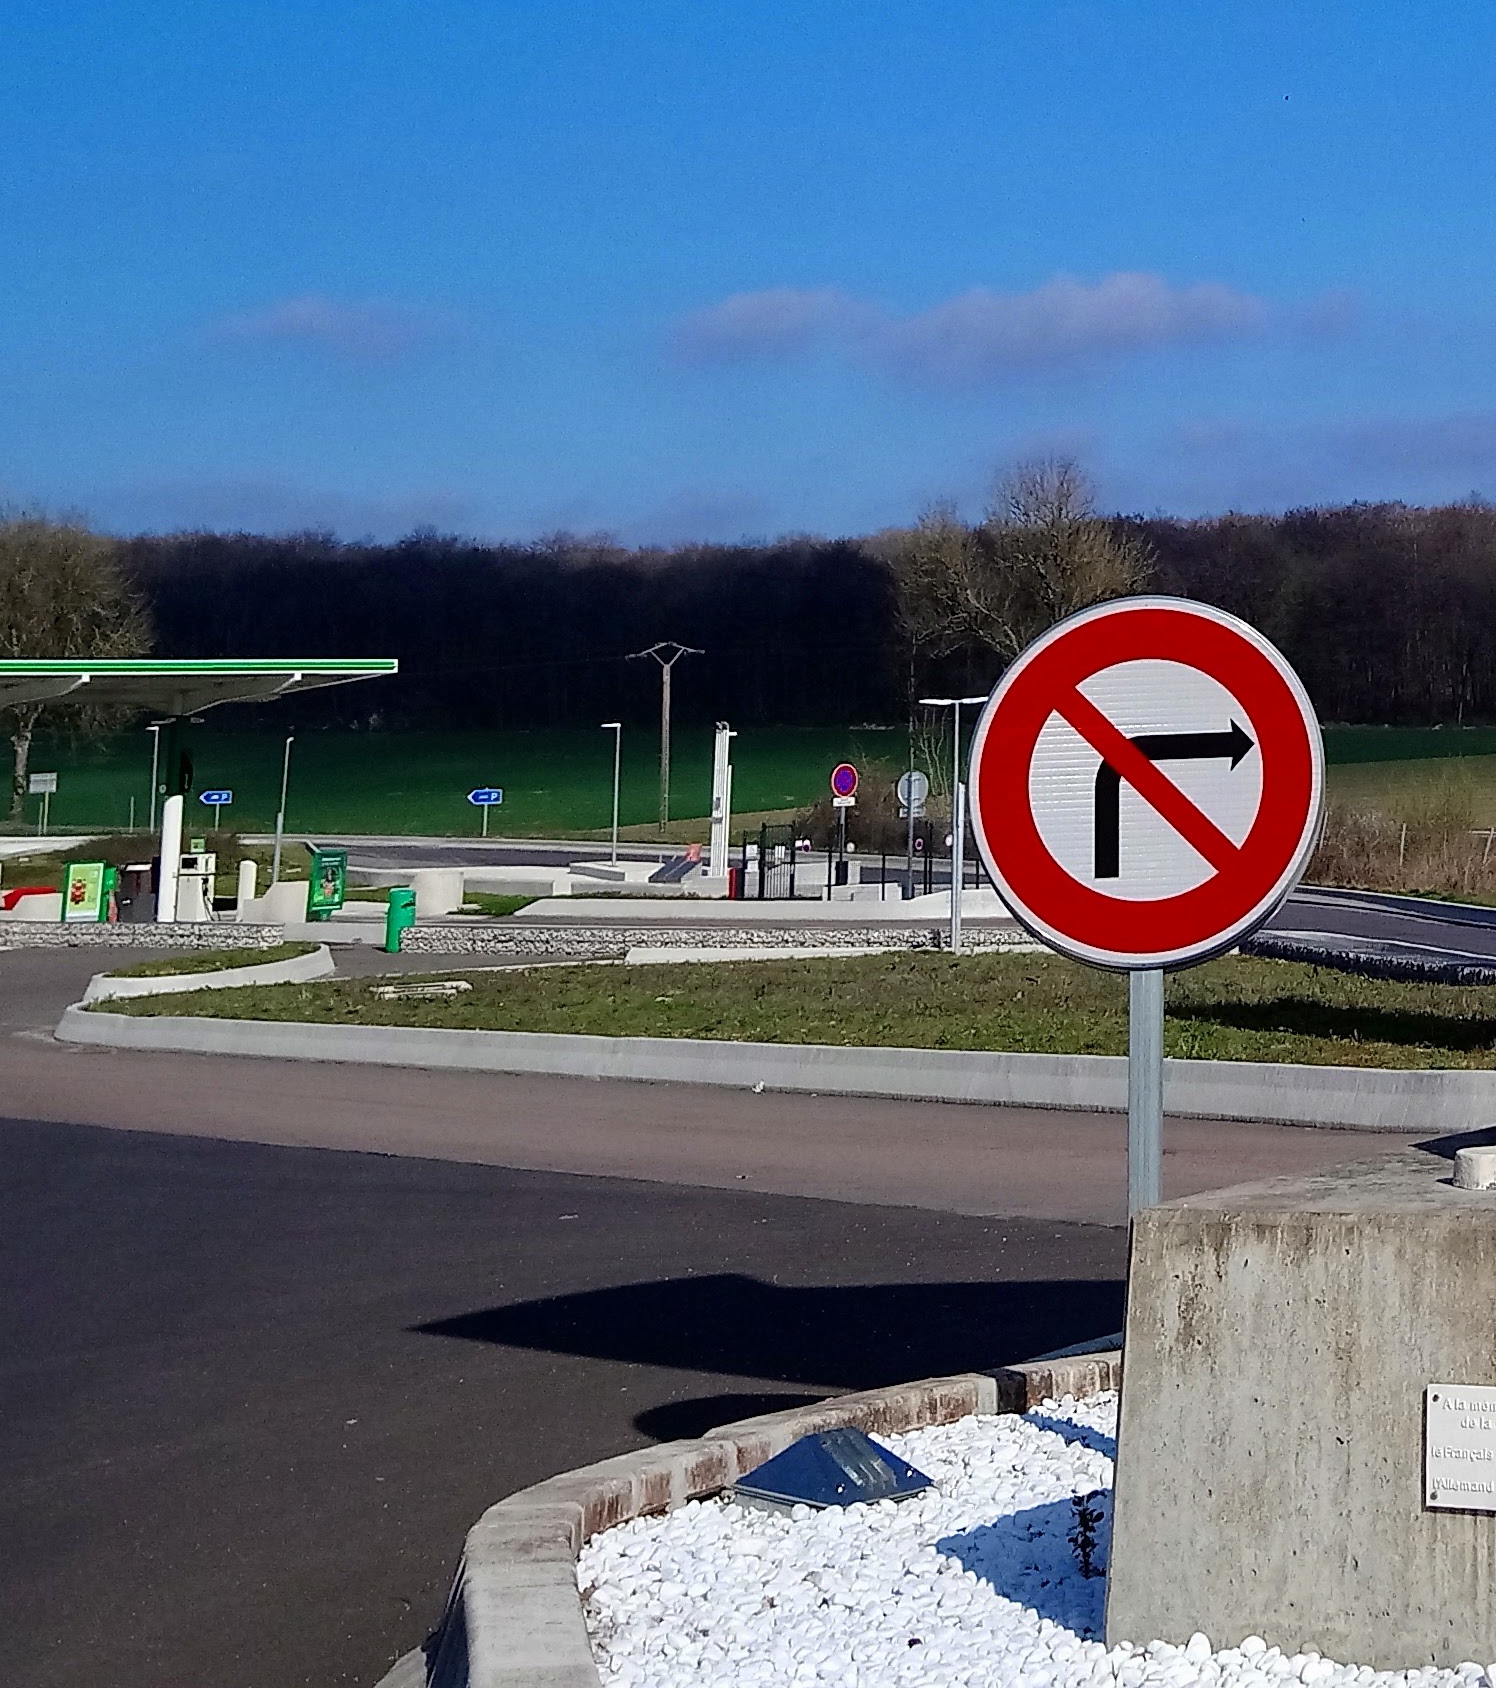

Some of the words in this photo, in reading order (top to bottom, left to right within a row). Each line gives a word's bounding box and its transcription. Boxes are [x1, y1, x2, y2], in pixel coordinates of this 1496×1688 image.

[1460, 1416, 1476, 1429] de
[1479, 1417, 1491, 1430] la
[1444, 1446, 1494, 1462] Français
